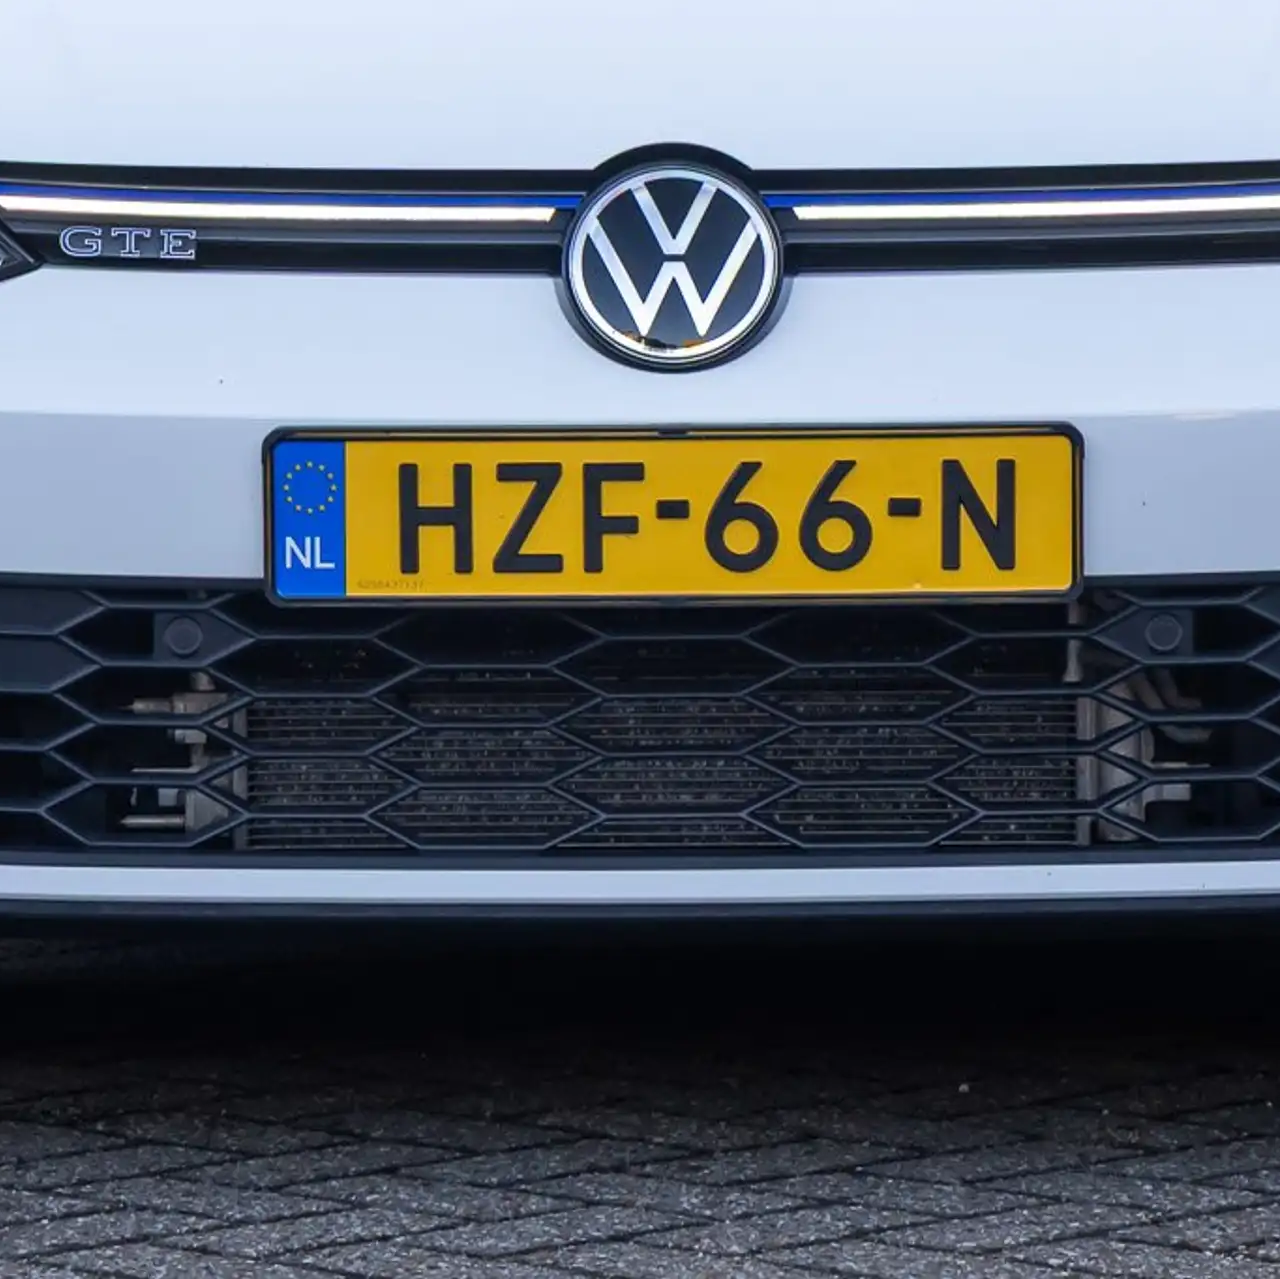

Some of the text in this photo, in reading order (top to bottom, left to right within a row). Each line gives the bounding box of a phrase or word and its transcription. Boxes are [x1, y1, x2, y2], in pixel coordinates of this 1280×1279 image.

[59, 225, 197, 260] GTE
[580, 174, 764, 342] VW
[285, 536, 335, 569] NL
[398, 458, 1016, 574] HZF-66-N
